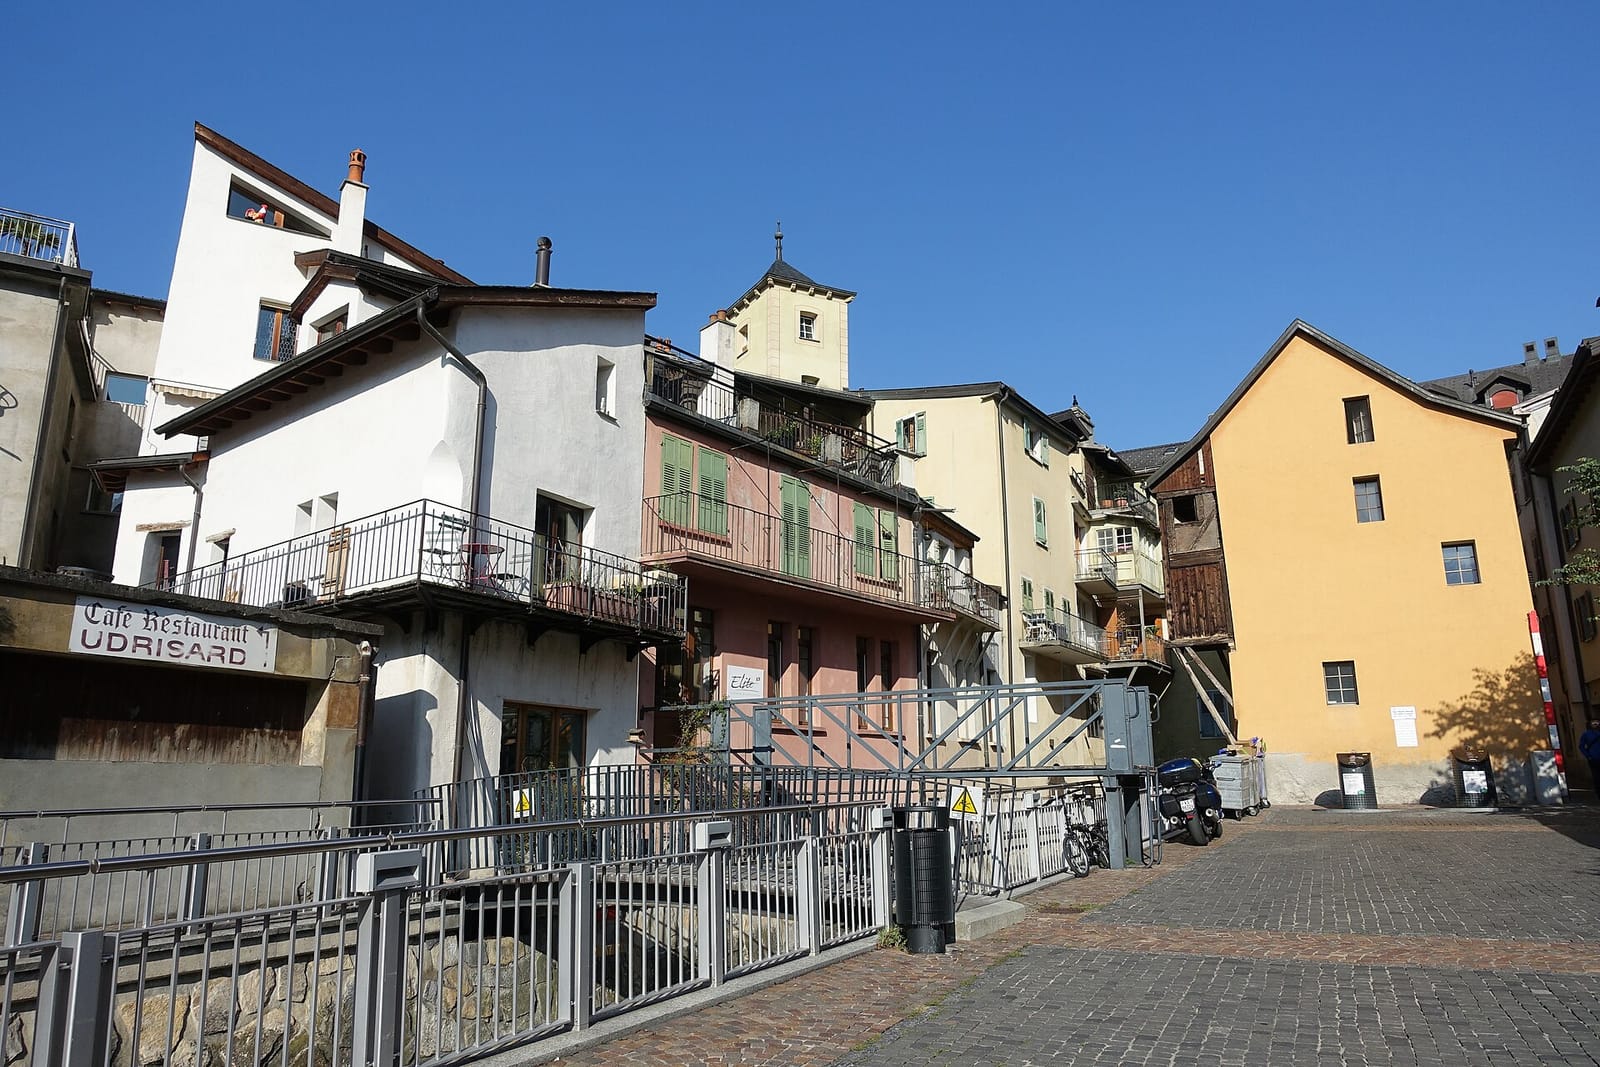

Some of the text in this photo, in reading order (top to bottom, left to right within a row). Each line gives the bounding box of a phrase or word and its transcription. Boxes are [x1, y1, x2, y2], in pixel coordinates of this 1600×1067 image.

[84, 602, 249, 643] Café Restaurant
[80, 629, 246, 666] UDRISARD
